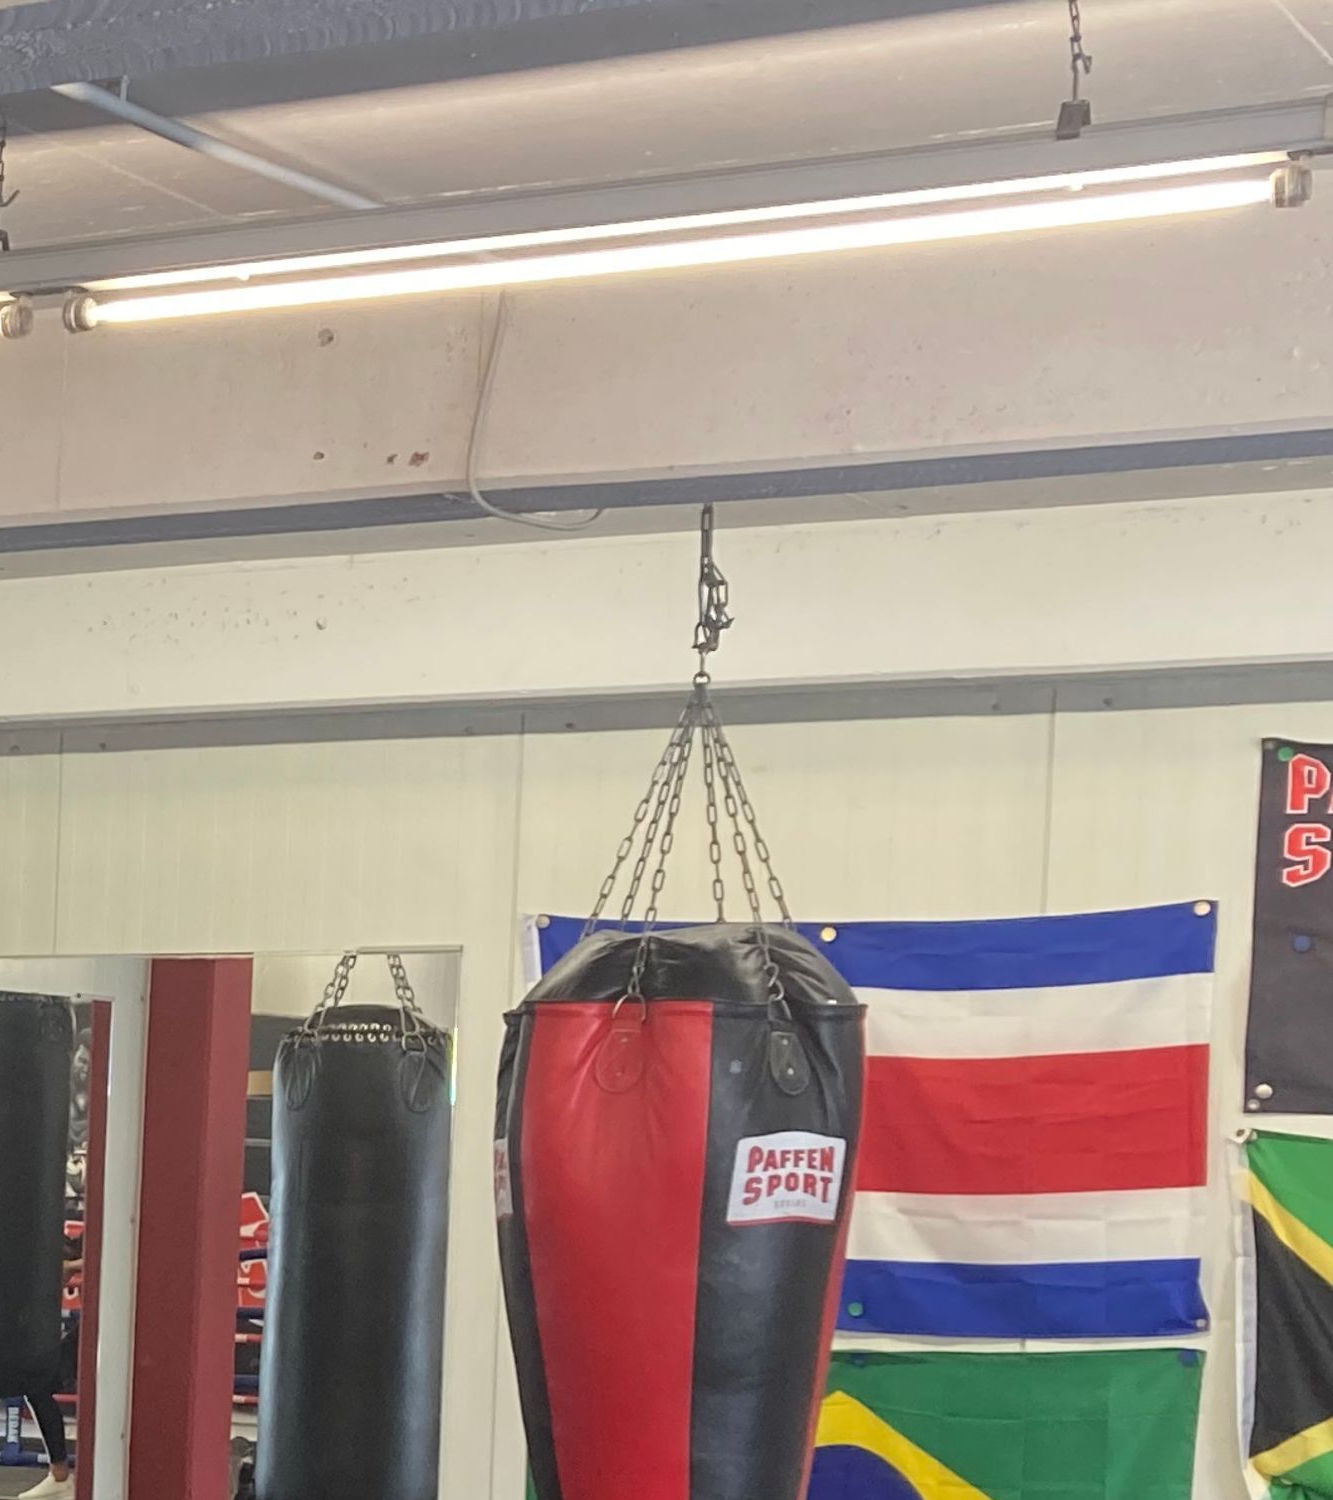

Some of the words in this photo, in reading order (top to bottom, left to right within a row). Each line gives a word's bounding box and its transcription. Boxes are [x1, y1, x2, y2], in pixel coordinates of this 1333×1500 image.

[1286, 754, 1333, 815] P
[746, 1145, 834, 1174] PAFFEN
[741, 1172, 833, 1206] SPORT
